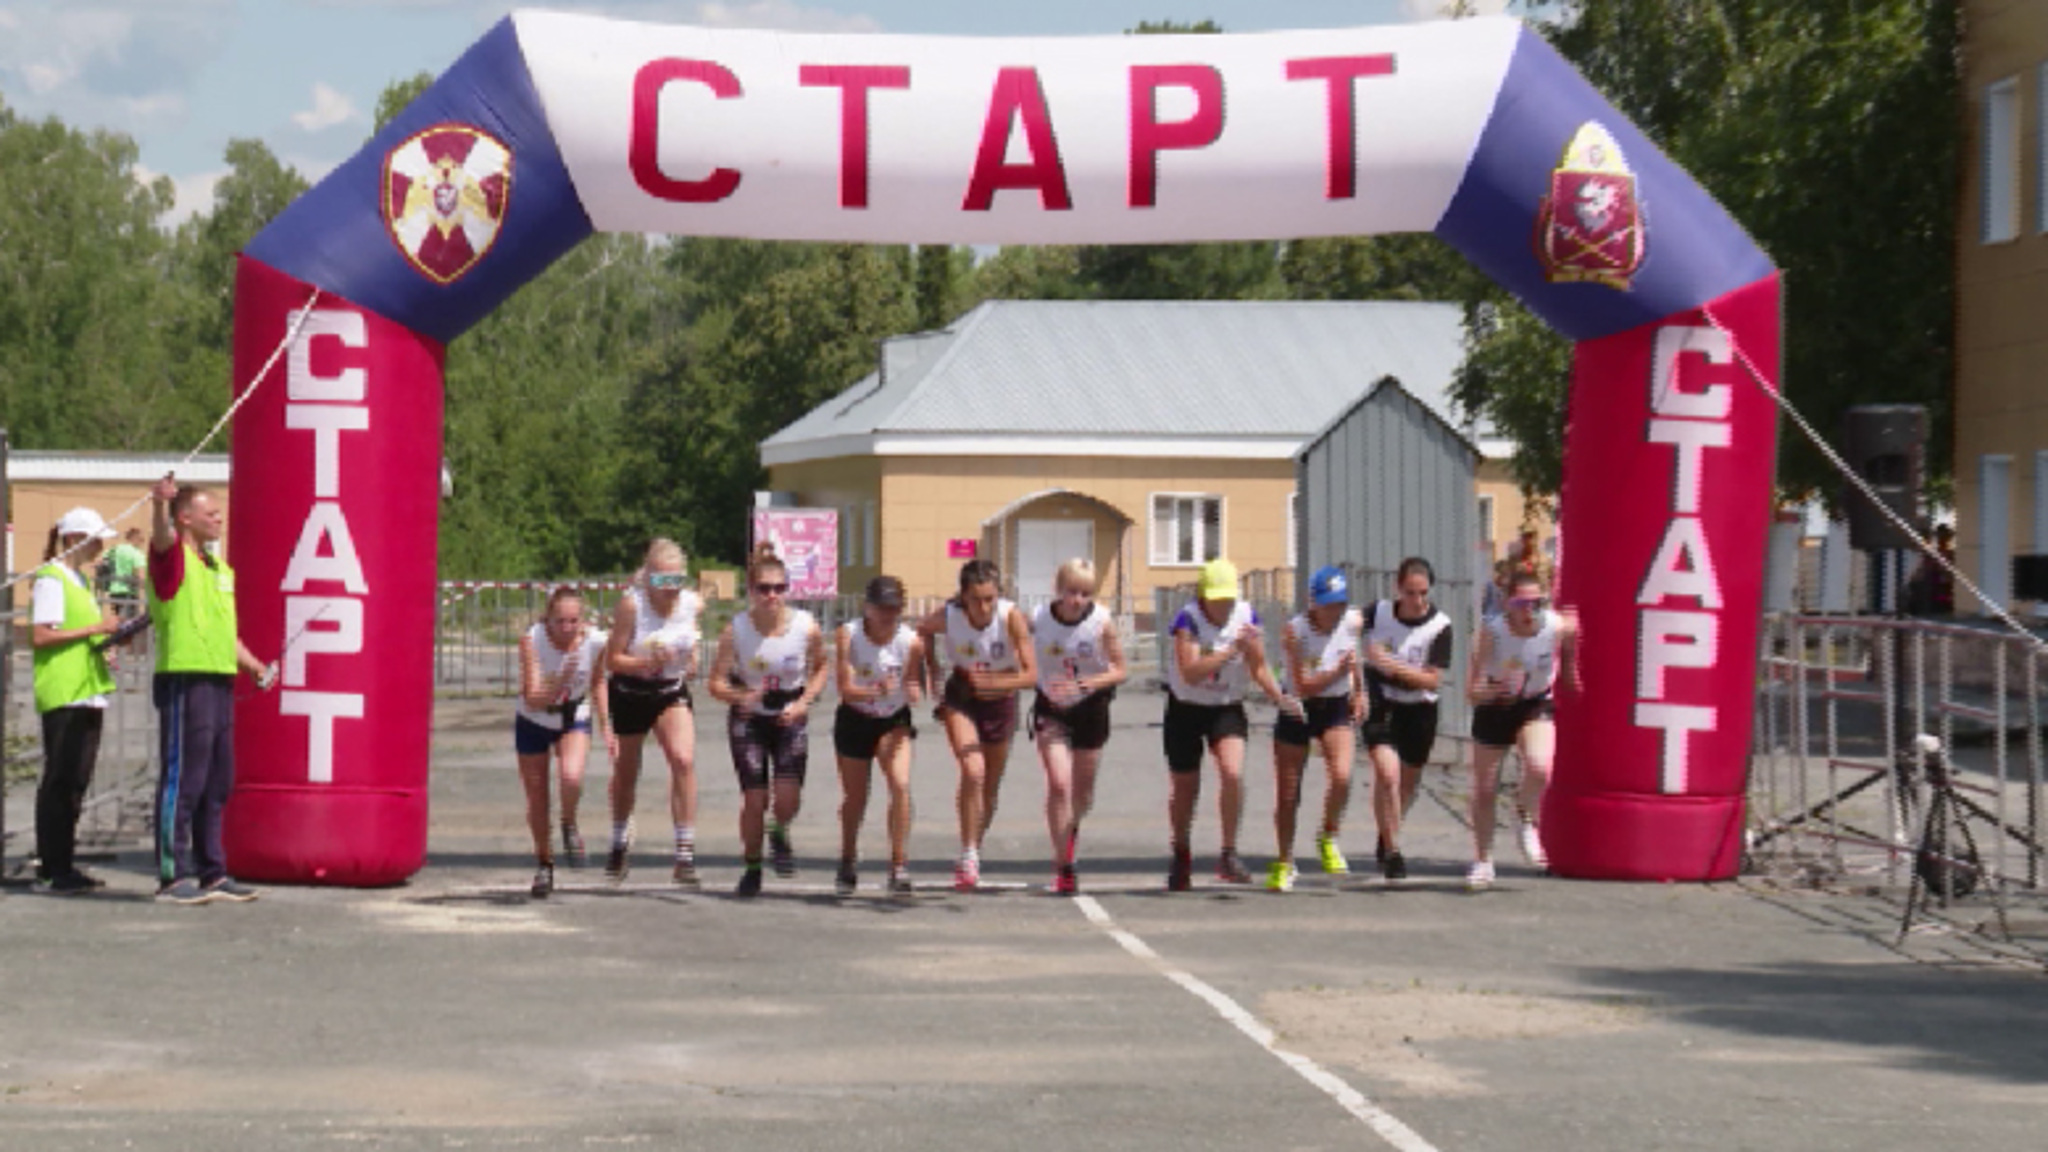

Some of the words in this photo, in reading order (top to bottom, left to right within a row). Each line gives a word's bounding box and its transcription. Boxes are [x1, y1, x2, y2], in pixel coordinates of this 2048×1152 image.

[628, 52, 1398, 211] СТАРТ
[279, 309, 369, 783] СТАРТ
[1634, 326, 1733, 795] СТАРТ
